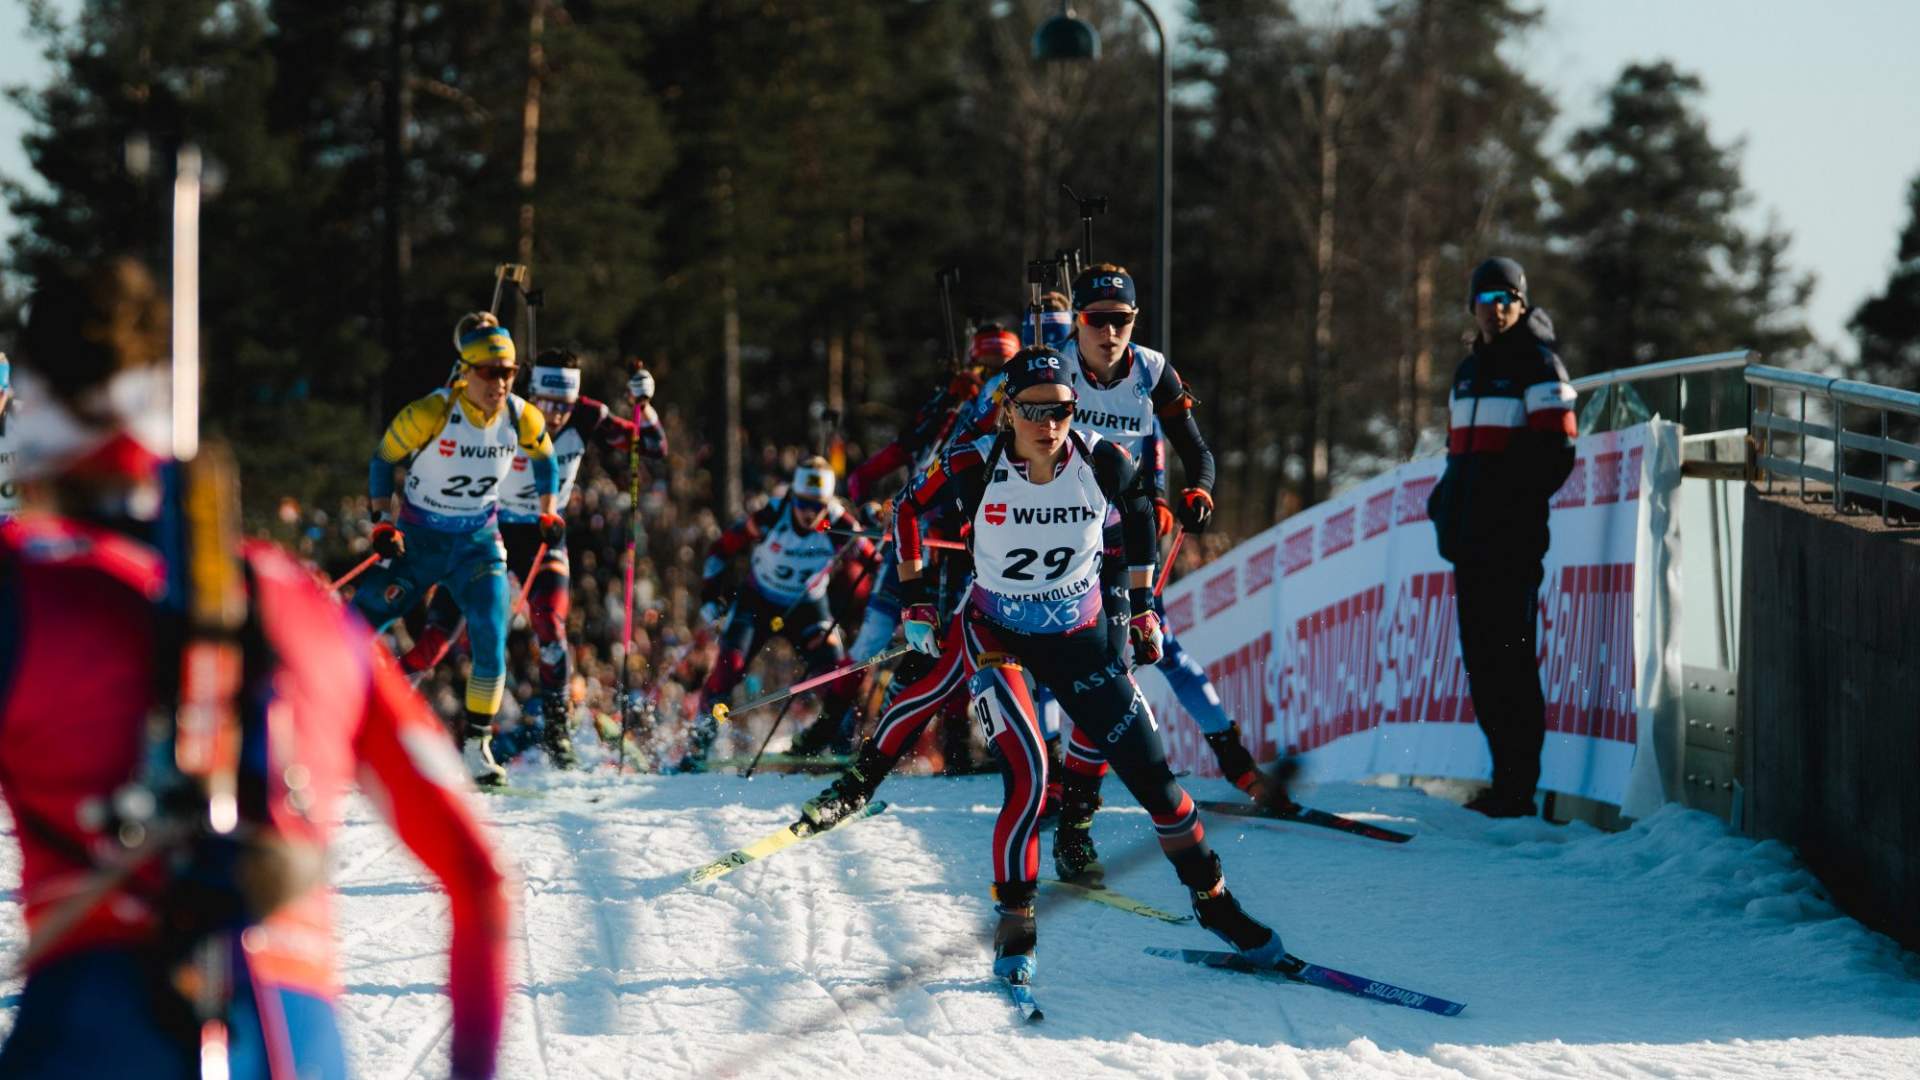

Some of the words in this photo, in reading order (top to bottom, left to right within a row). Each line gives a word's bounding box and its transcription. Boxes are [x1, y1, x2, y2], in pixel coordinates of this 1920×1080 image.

[1074, 408, 1141, 432] WÜRTH
[441, 475, 498, 498] 23
[1012, 506, 1096, 525] WÜRTH
[1001, 546, 1076, 581] 29
[985, 578, 1090, 603] LMENKOLLEN
[1040, 599, 1080, 628] X3
[1548, 580, 1637, 724] BAUHAU
[975, 696, 995, 740] 9
[1364, 981, 1428, 1008] SALOMON
